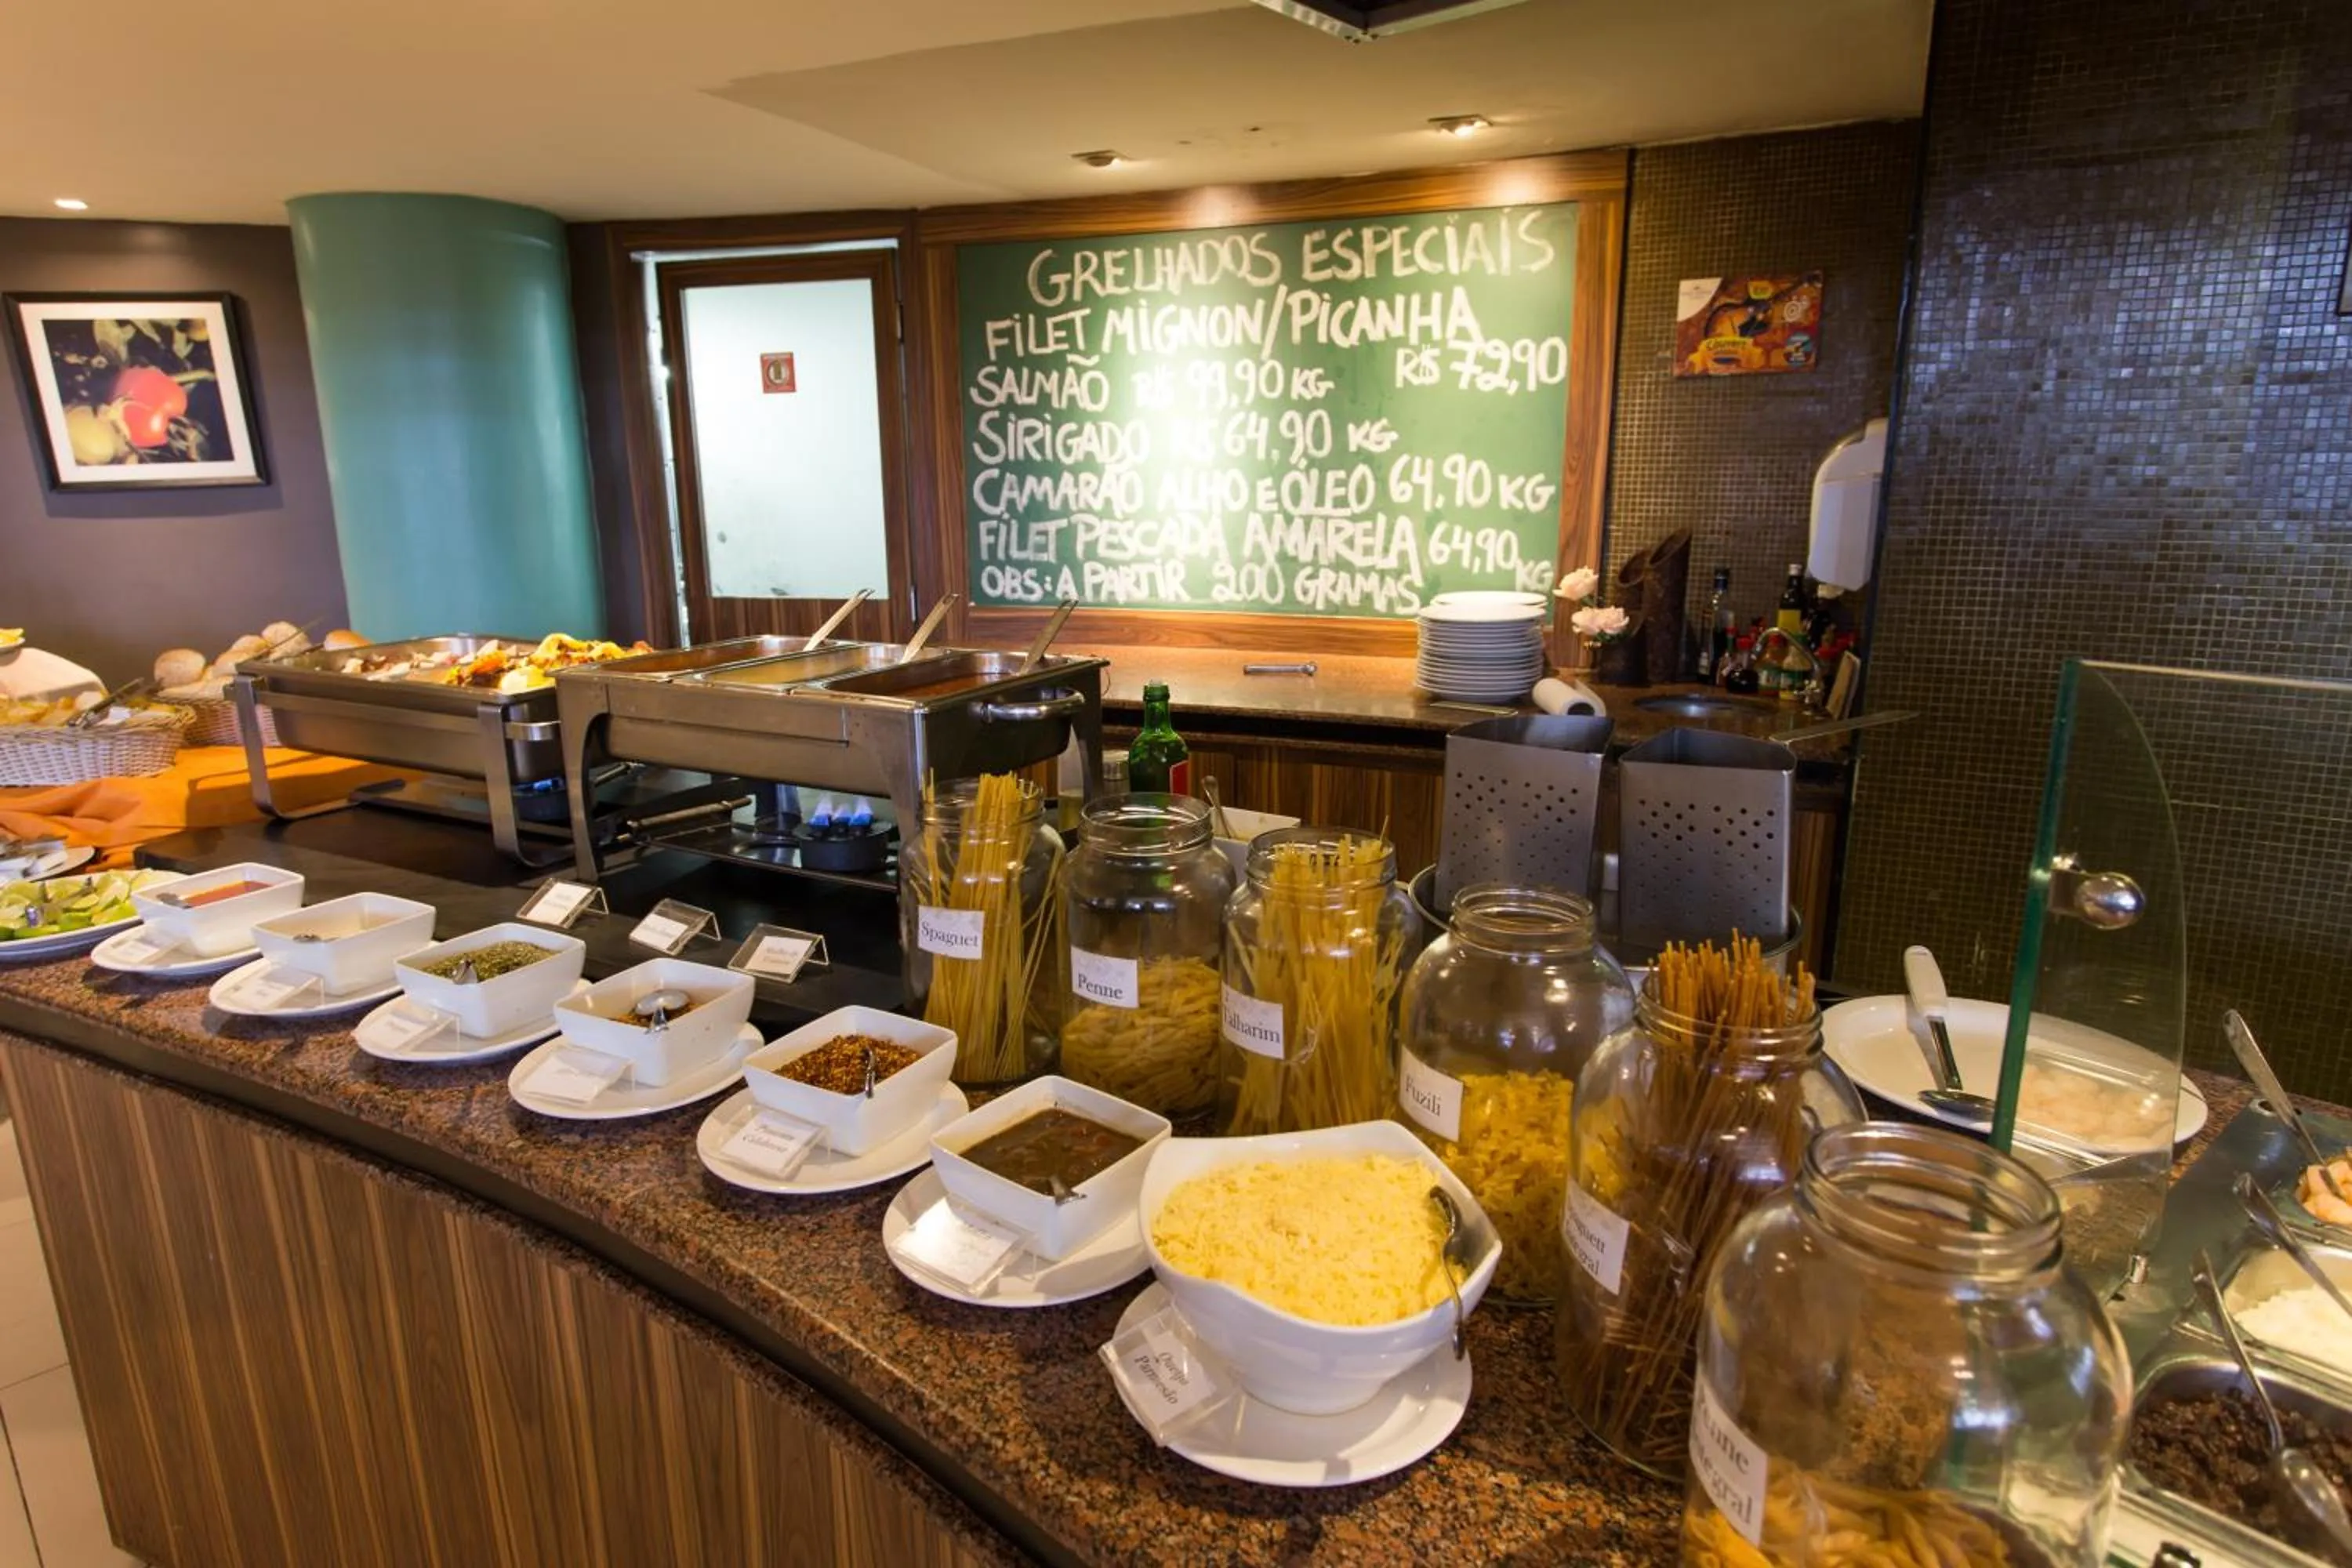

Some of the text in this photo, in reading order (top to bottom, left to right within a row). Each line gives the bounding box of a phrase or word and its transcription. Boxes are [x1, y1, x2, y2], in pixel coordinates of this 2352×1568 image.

[1028, 233, 1282, 307] GRELHADOS
[985, 308, 1091, 361] FILET
[970, 354, 1109, 412] SALMÃO
[1186, 358, 1285, 412] 99,90
[1291, 367, 1334, 400] KG
[1396, 336, 1567, 396] R$ 72,90
[972, 409, 1150, 466] SIRIGADO
[1223, 409, 1332, 465] 64,90
[1348, 418, 1399, 452] KG
[973, 464, 1143, 518] CAMARÃO
[1156, 468, 1249, 514] ALHO
[1280, 458, 1376, 515] ÓLEO
[1389, 453, 1490, 511] 64,90
[1497, 473, 1555, 513] KG
[979, 512, 1554, 592] FILET PESCADA AMARELA 64,90 KG
[1054, 564, 1079, 601] A
[1083, 560, 1191, 603] PARTIR
[1211, 560, 1285, 604] 200
[1294, 566, 1421, 615] GRAMAS
[1078, 973, 1123, 1000] Penne
